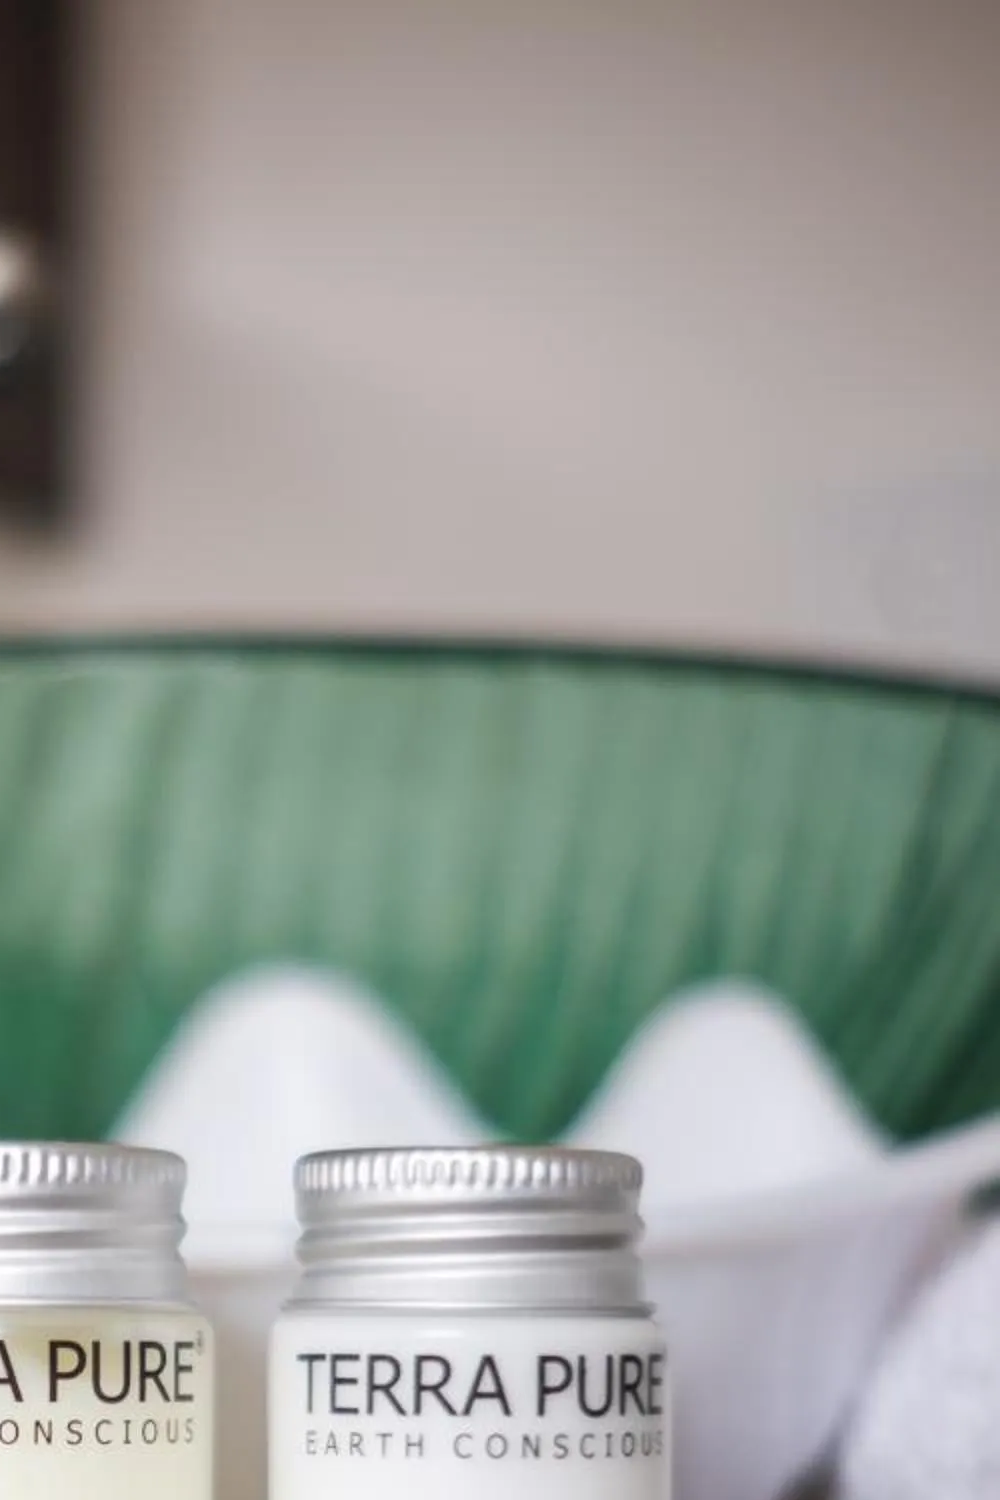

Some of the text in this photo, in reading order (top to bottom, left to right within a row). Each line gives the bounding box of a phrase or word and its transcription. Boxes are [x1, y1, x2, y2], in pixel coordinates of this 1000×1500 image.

[296, 1353, 664, 1418] TERRA PURE
[305, 1430, 663, 1459] EARTH CONSCIOUS
